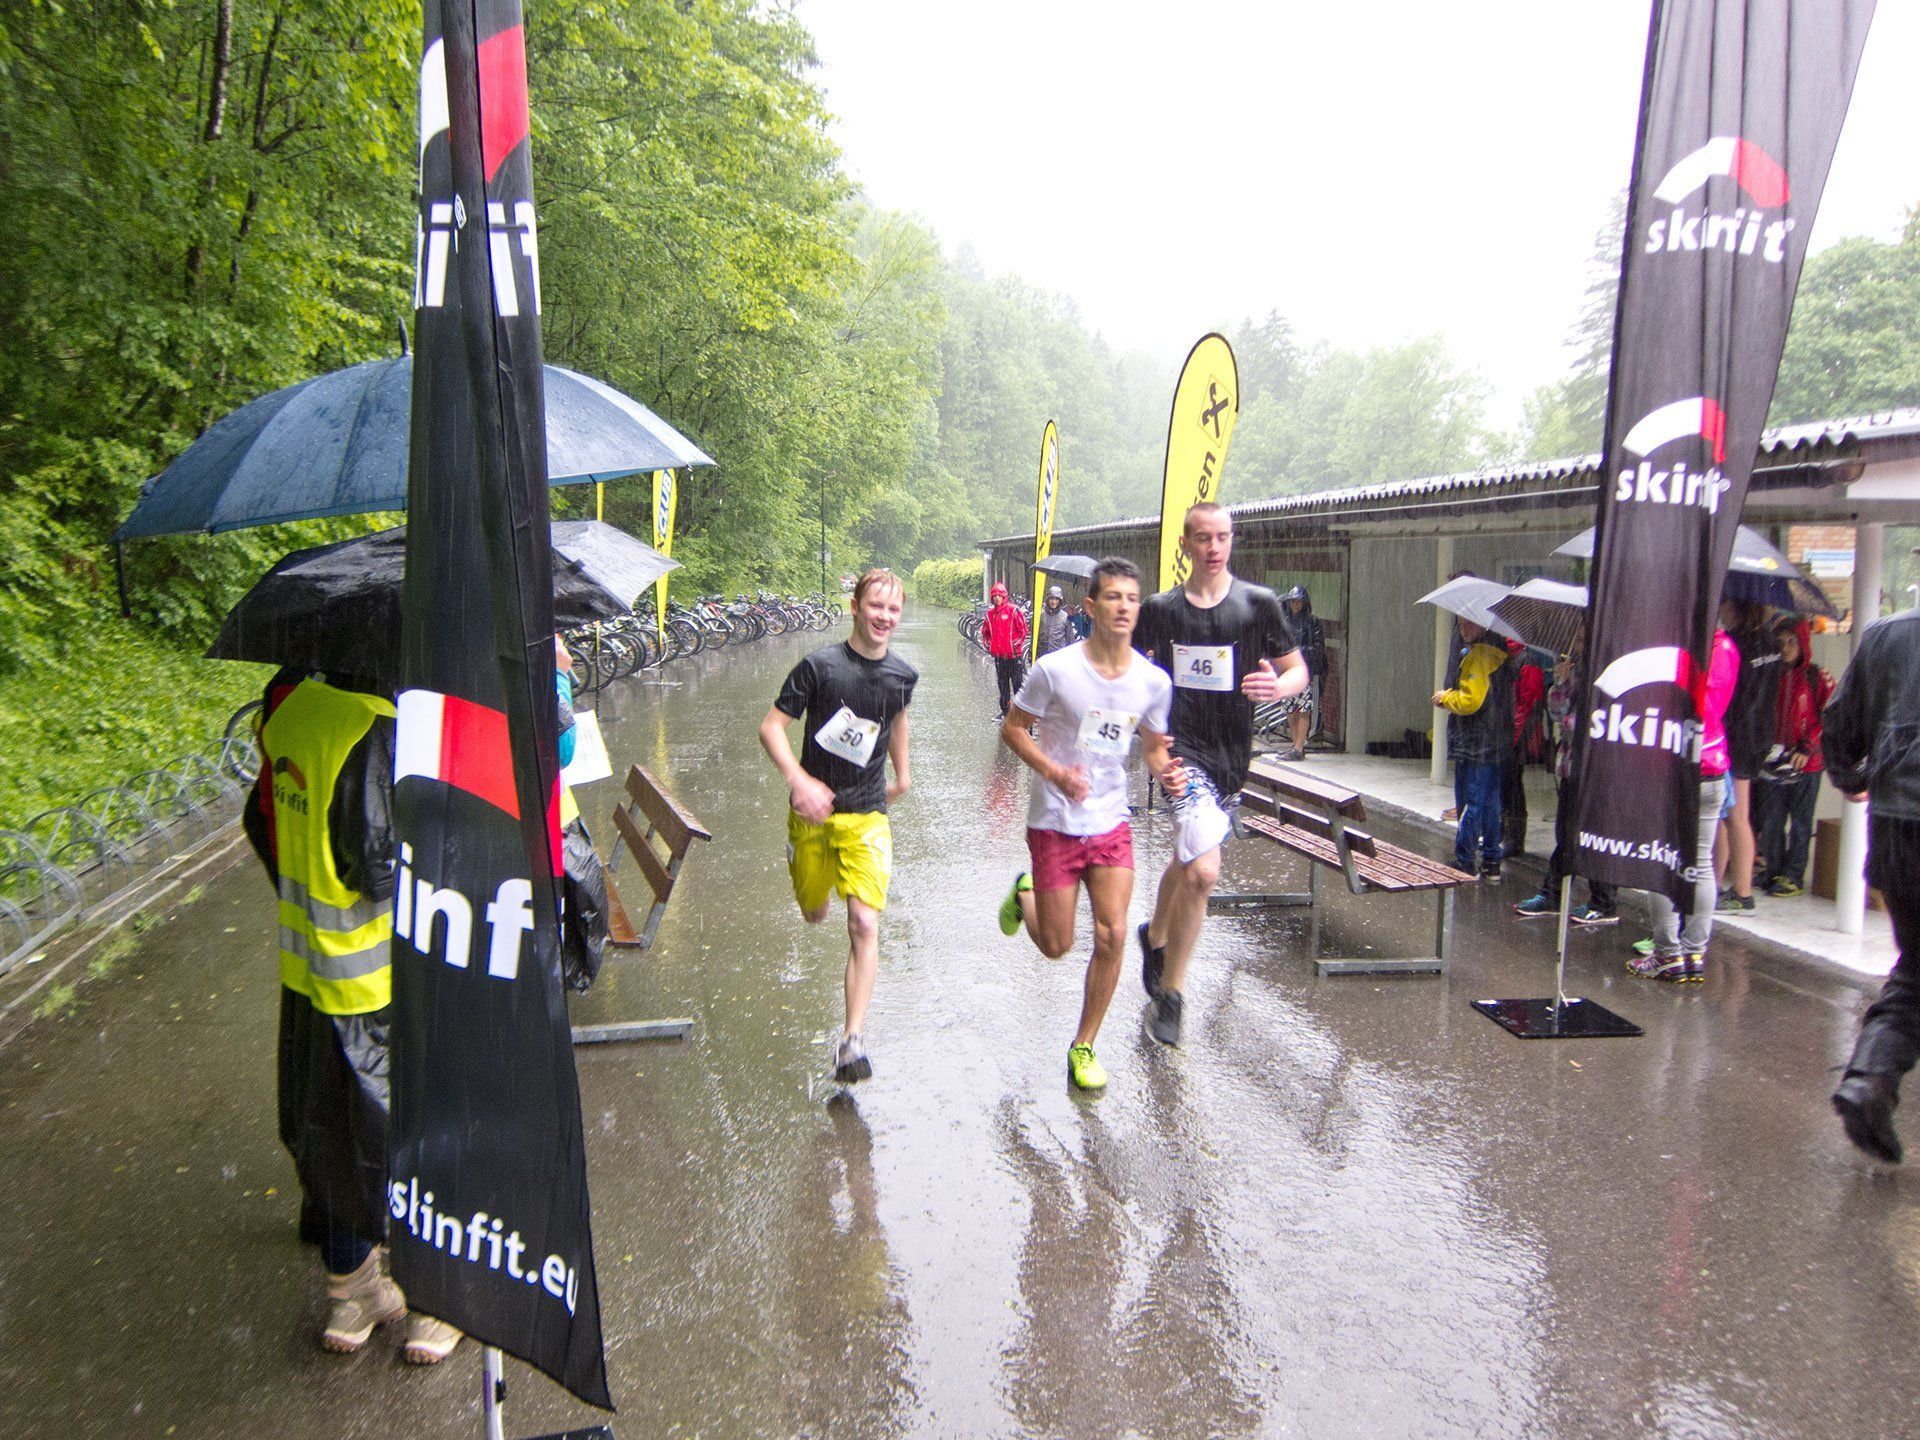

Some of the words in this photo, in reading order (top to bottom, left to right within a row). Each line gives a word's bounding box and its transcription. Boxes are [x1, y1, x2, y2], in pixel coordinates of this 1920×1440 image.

[658, 471, 673, 537] CLUB
[1190, 658, 1213, 676] 46
[839, 728, 863, 747] 50
[1098, 722, 1122, 741] 45
